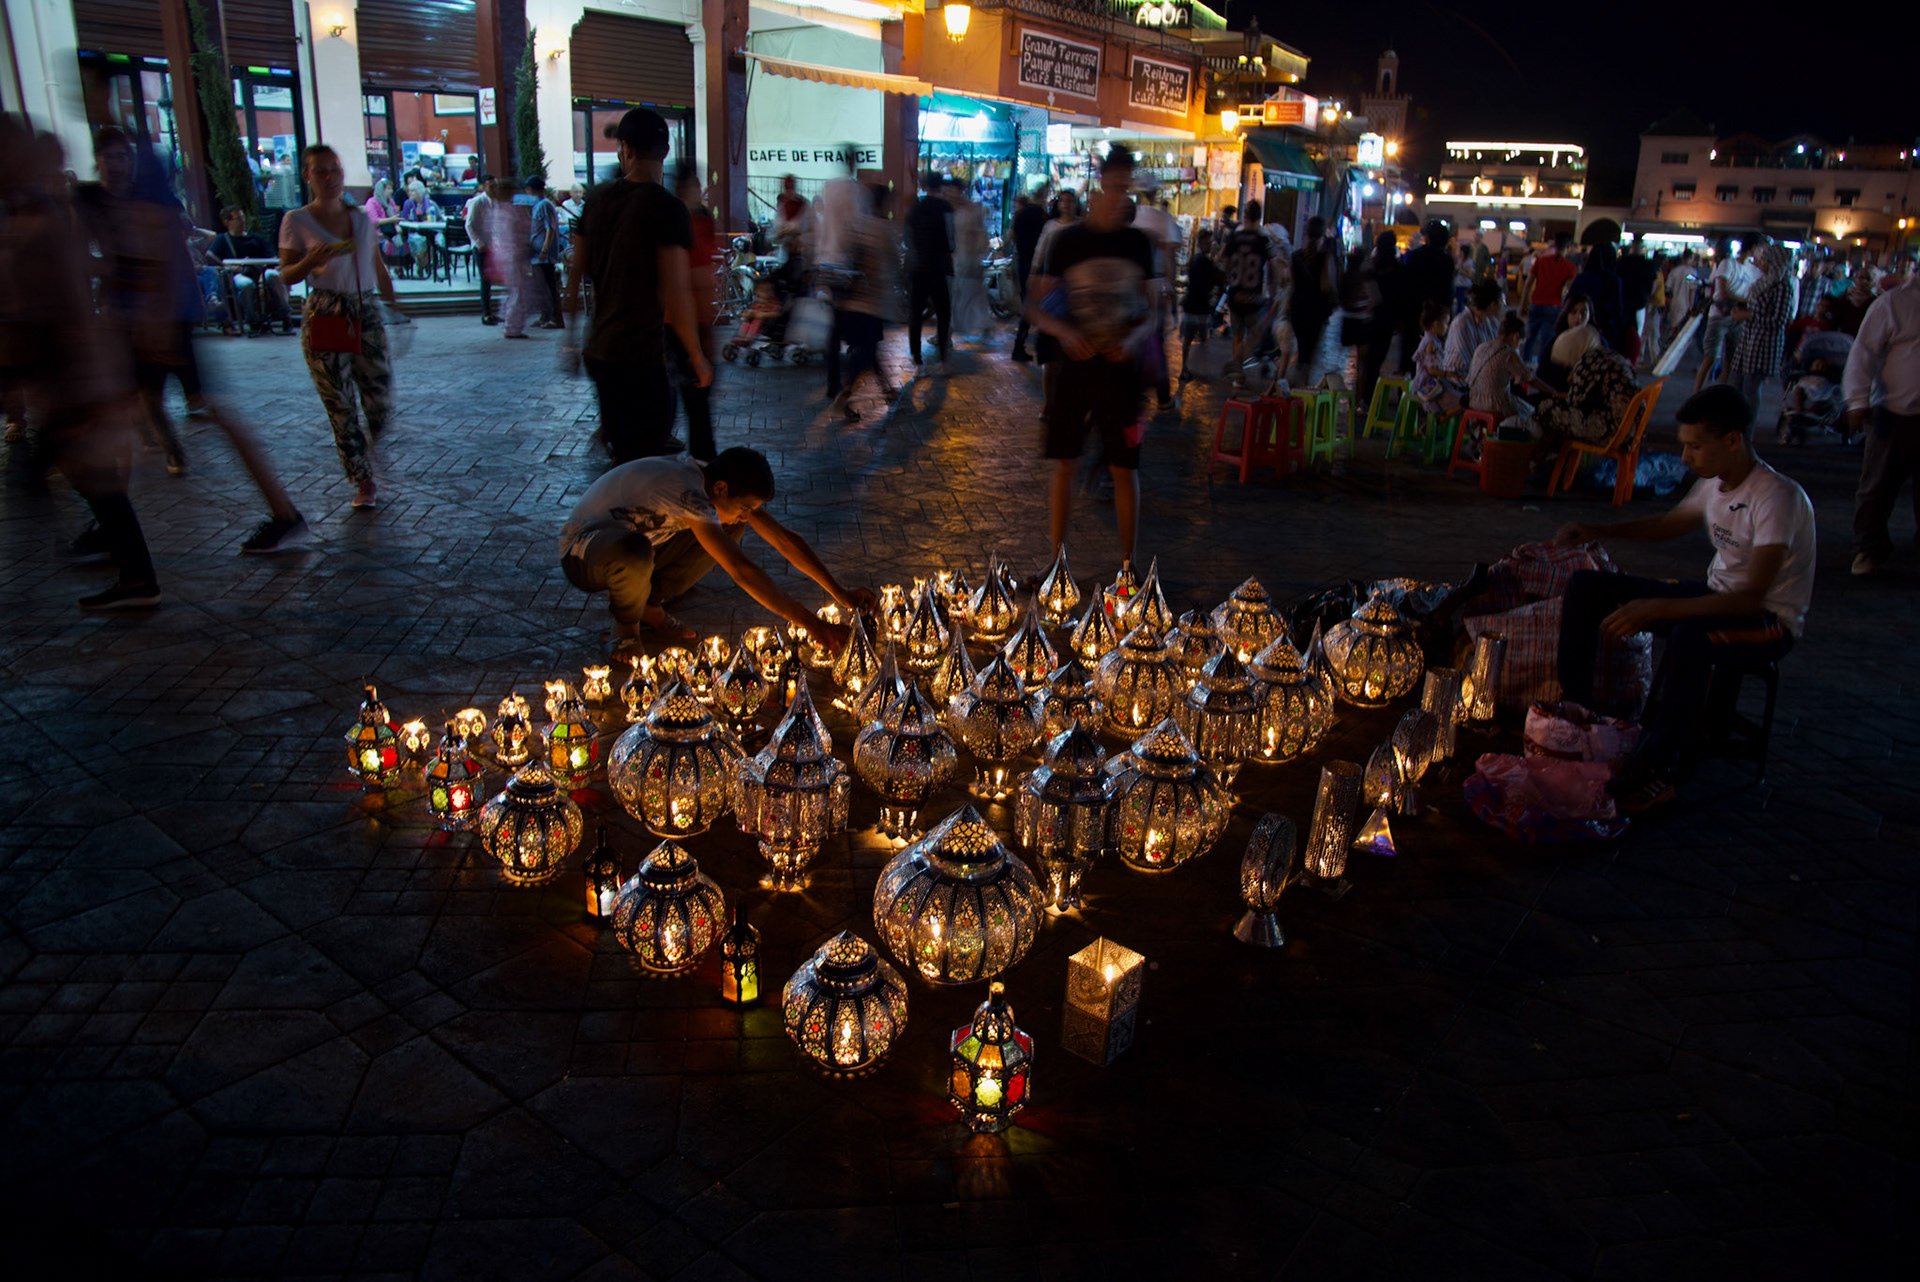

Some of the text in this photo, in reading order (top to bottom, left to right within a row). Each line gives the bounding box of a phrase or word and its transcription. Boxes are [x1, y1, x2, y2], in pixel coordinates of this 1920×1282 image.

[1136, 7, 1188, 26] AQUA
[1024, 35, 1097, 67] Grande Terrasse
[791, 150, 809, 162] DE
